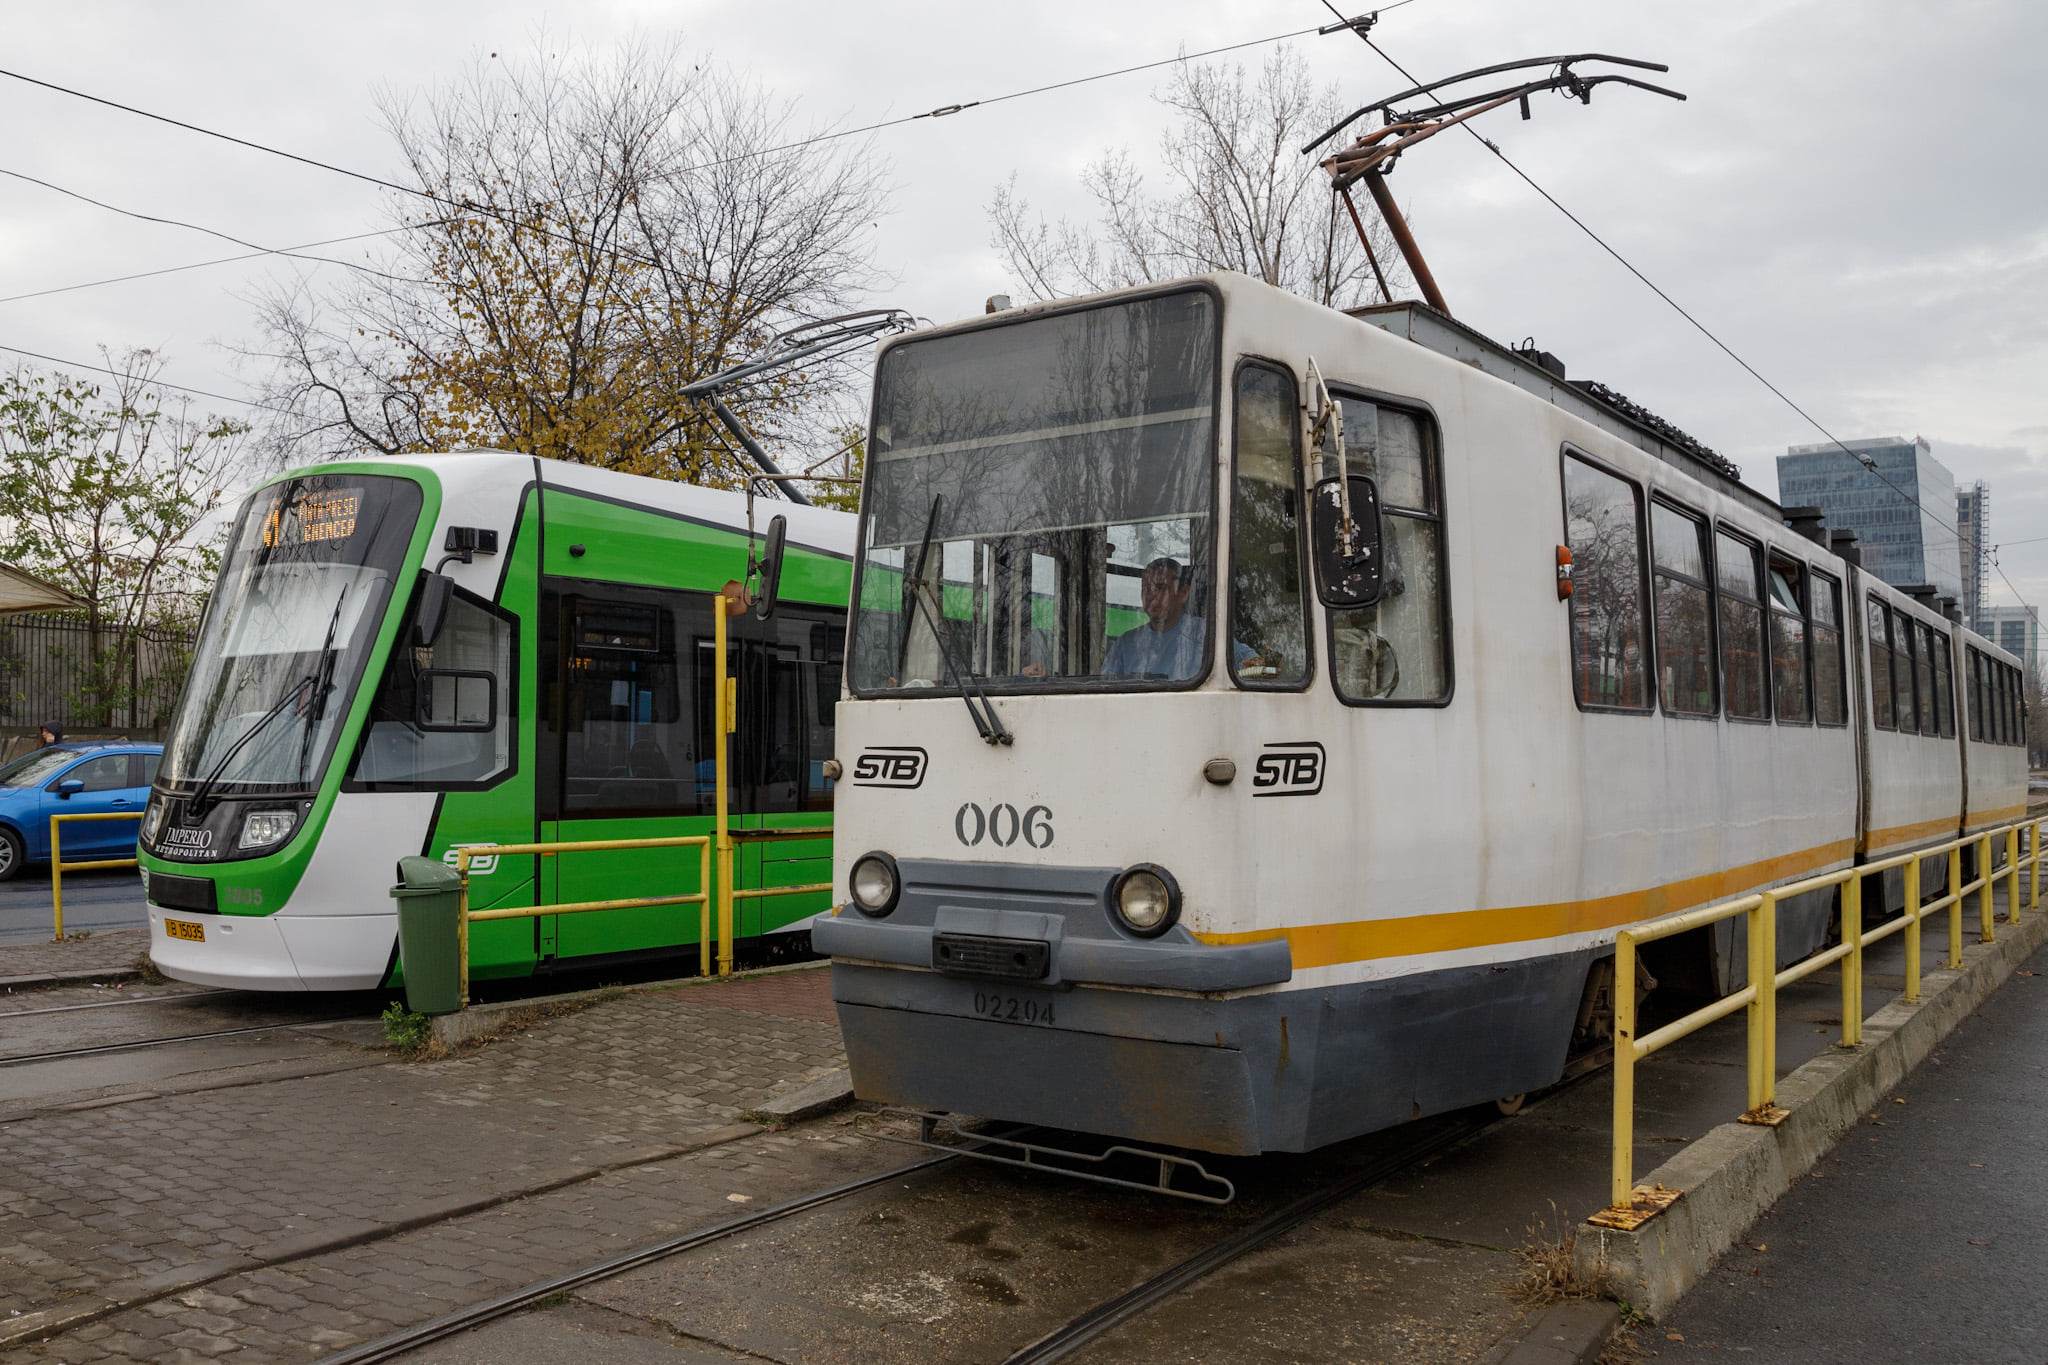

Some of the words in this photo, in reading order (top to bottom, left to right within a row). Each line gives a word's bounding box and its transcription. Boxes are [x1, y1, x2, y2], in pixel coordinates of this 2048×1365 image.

[853, 752, 922, 782] STB
[1252, 750, 1320, 789] STB
[162, 827, 212, 848] IMPERIO
[955, 802, 1054, 849] 006
[154, 844, 218, 858] METROPOLITAN
[442, 848, 496, 871] SB
[170, 921, 177, 936] B
[974, 991, 1056, 1026] 02204
